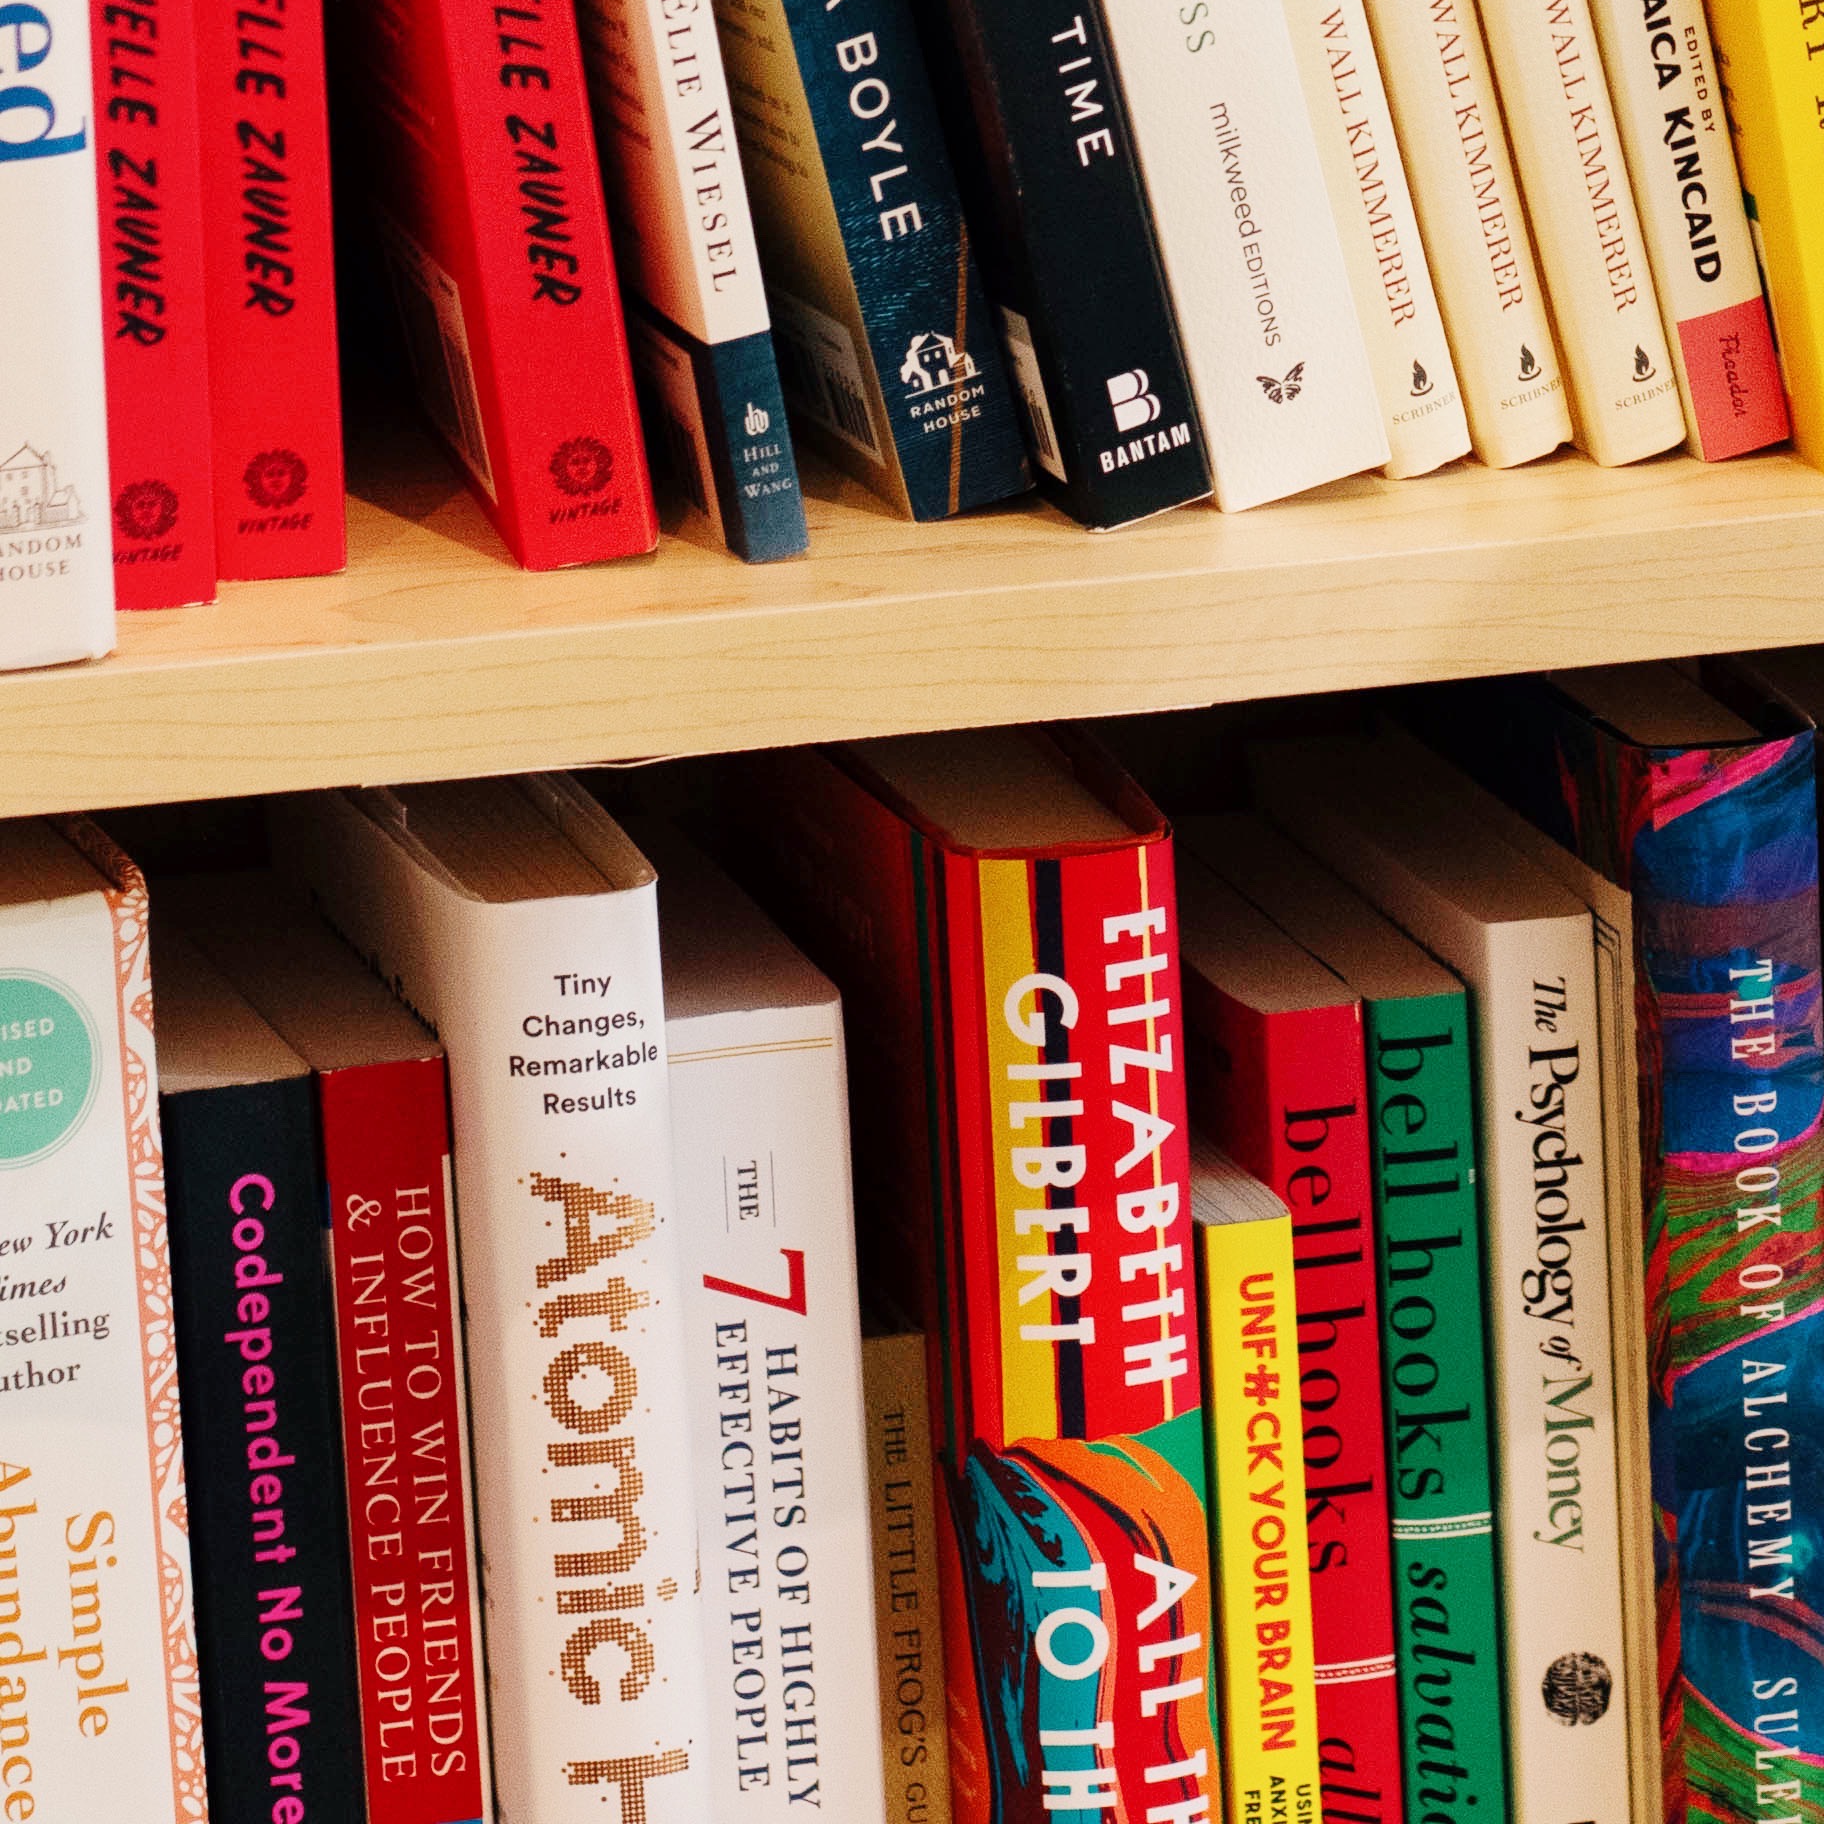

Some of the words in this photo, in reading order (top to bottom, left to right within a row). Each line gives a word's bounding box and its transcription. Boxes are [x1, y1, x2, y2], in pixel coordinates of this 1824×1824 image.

[836, 30, 924, 242] BOYLE
[1050, 16, 1115, 166] TIME
[507, 113, 583, 307] ZAUNER
[683, 110, 744, 294] WIESEL
[1208, 101, 1262, 238] milkweed
[1241, 242, 1282, 348] EDITIONS
[1453, 106, 1526, 315] KIMMERER
[1661, 105, 1724, 285] KINCAID
[1099, 422, 1191, 474] BANTAM
[509, 1041, 659, 1079] Remarkable
[521, 1009, 647, 1041] Changes,
[554, 971, 613, 1001] Tiny
[1530, 976, 1566, 1035] The
[543, 1085, 638, 1116] Results
[1004, 974, 1096, 1345] GILBERT
[1103, 905, 1189, 1393] ELIZABETH
[1516, 1042, 1586, 1332] Psychology
[735, 1160, 760, 1221] THE
[226, 1172, 297, 1563] Codependent
[704, 1246, 808, 1317] 7
[1541, 1334, 1582, 1373] of
[714, 1319, 760, 1595] EFFECTIVE
[764, 1344, 810, 1529] HABITS
[1537, 1376, 1595, 1552] Money
[257, 1586, 304, 1661] No
[775, 1533, 813, 1603] OF
[263, 1681, 311, 1824] More
[730, 1610, 771, 1793] PEOPLE
[779, 1619, 822, 1811] HIGHLY
